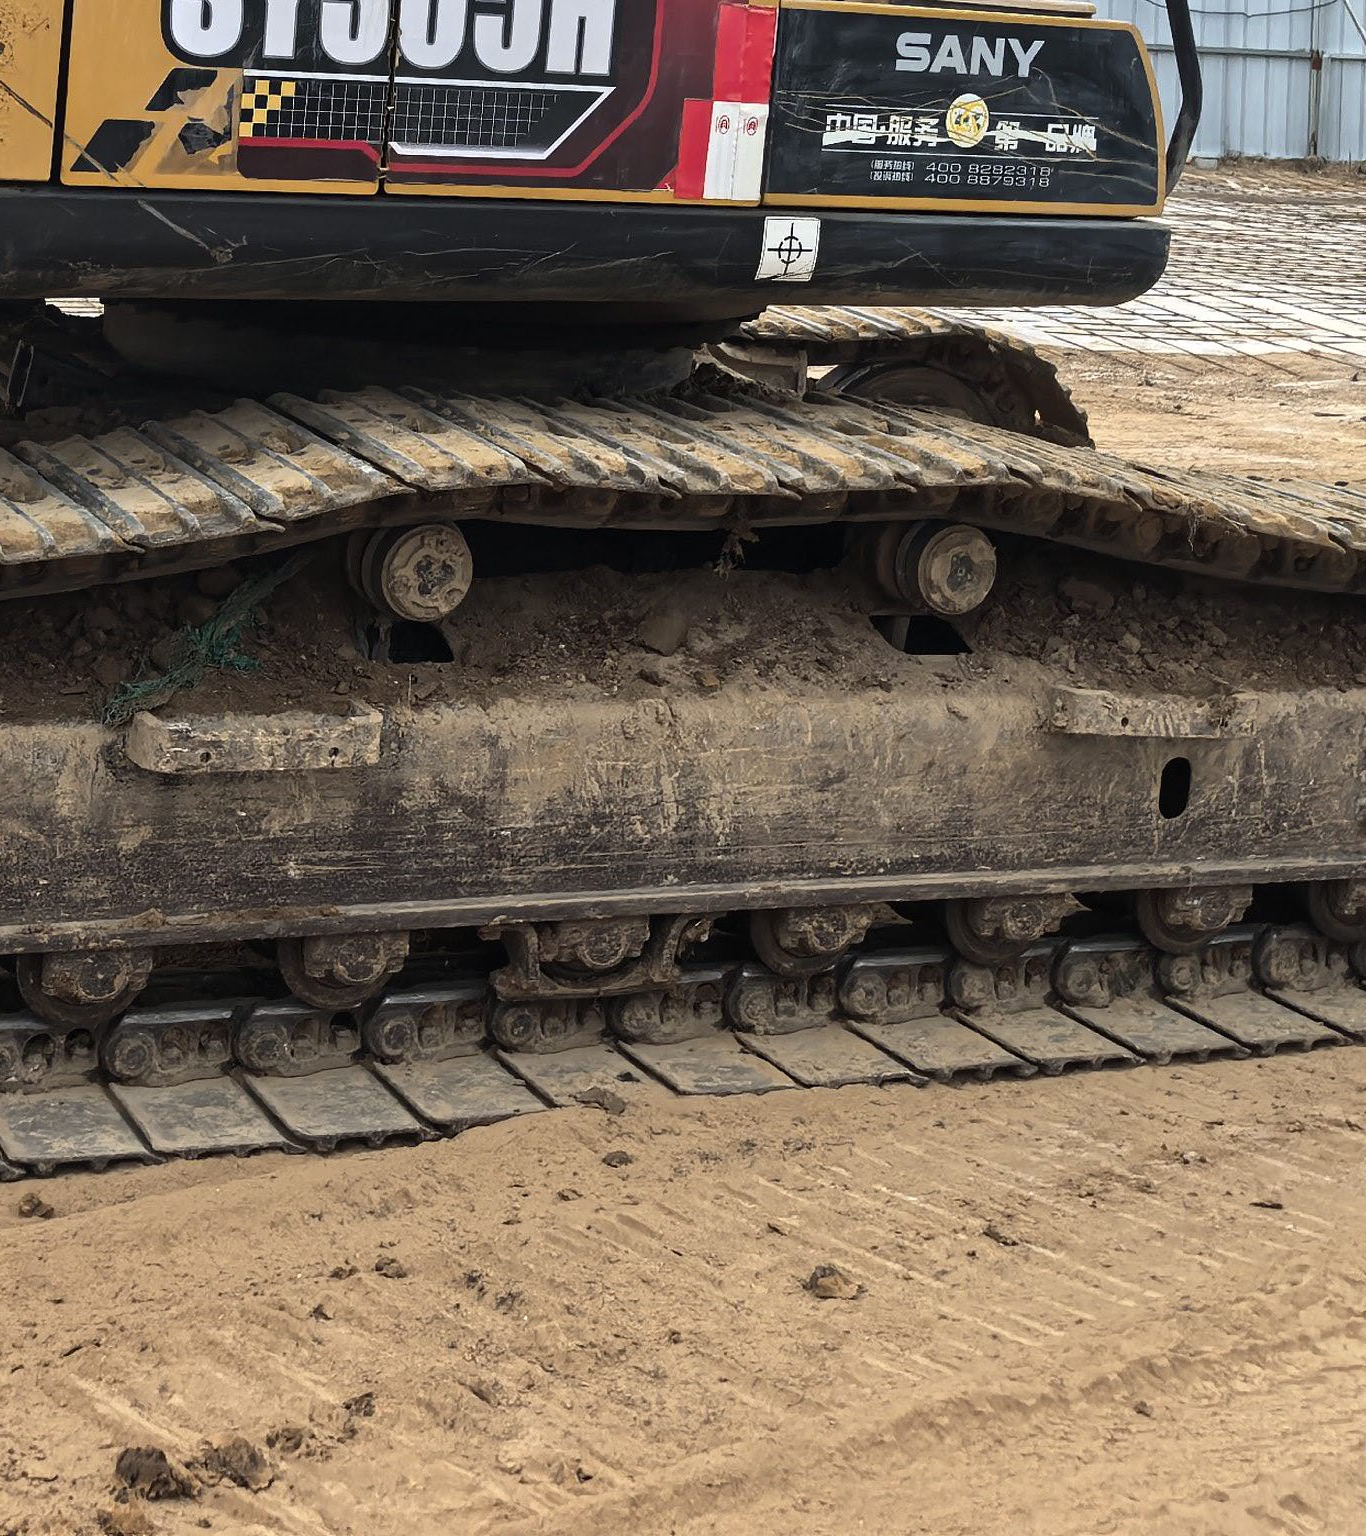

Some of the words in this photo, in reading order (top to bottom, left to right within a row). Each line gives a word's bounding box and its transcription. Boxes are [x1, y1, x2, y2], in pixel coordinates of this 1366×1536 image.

[895, 31, 1045, 78] SANY
[925, 162, 962, 174] 400
[968, 164, 1051, 177] 8282318
[924, 173, 961, 185] 400
[966, 175, 1050, 188] 8879318
